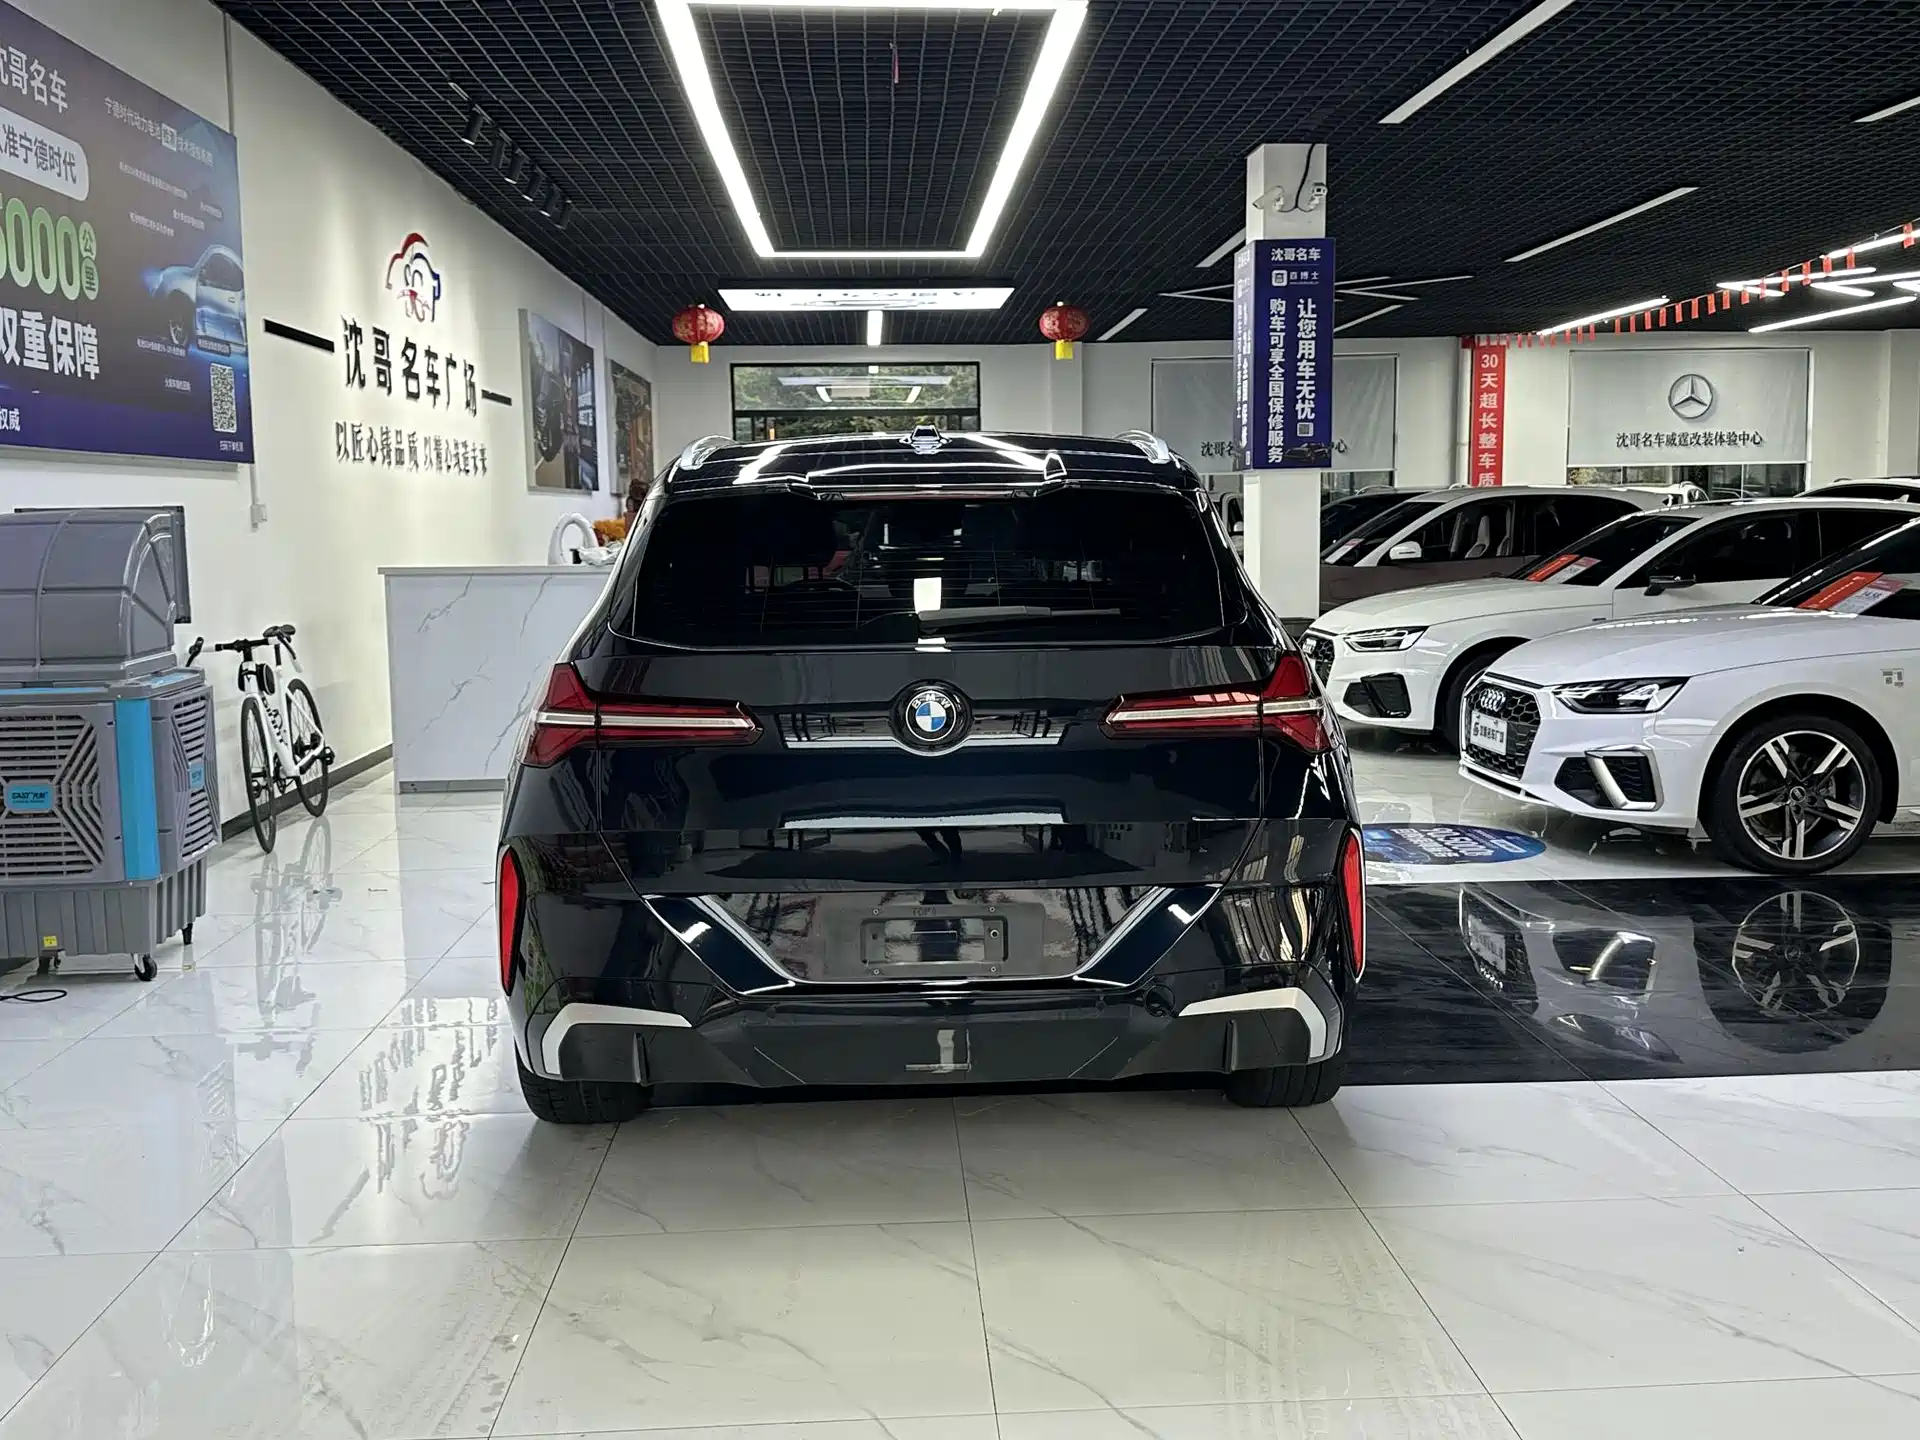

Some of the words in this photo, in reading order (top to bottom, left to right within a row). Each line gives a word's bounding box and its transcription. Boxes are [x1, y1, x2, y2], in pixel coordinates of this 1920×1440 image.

[1271, 248, 1321, 261] 沈哥名车
[0, 307, 100, 380] 双重保障
[341, 315, 477, 417] 沈哥名车广场
[1295, 298, 1317, 420] 让您用车无忧
[1268, 299, 1286, 463] 购车可享全国保修服务
[1616, 431, 1763, 449] 沈哥名车威霆改装体验中心
[911, 693, 952, 710] BMW
